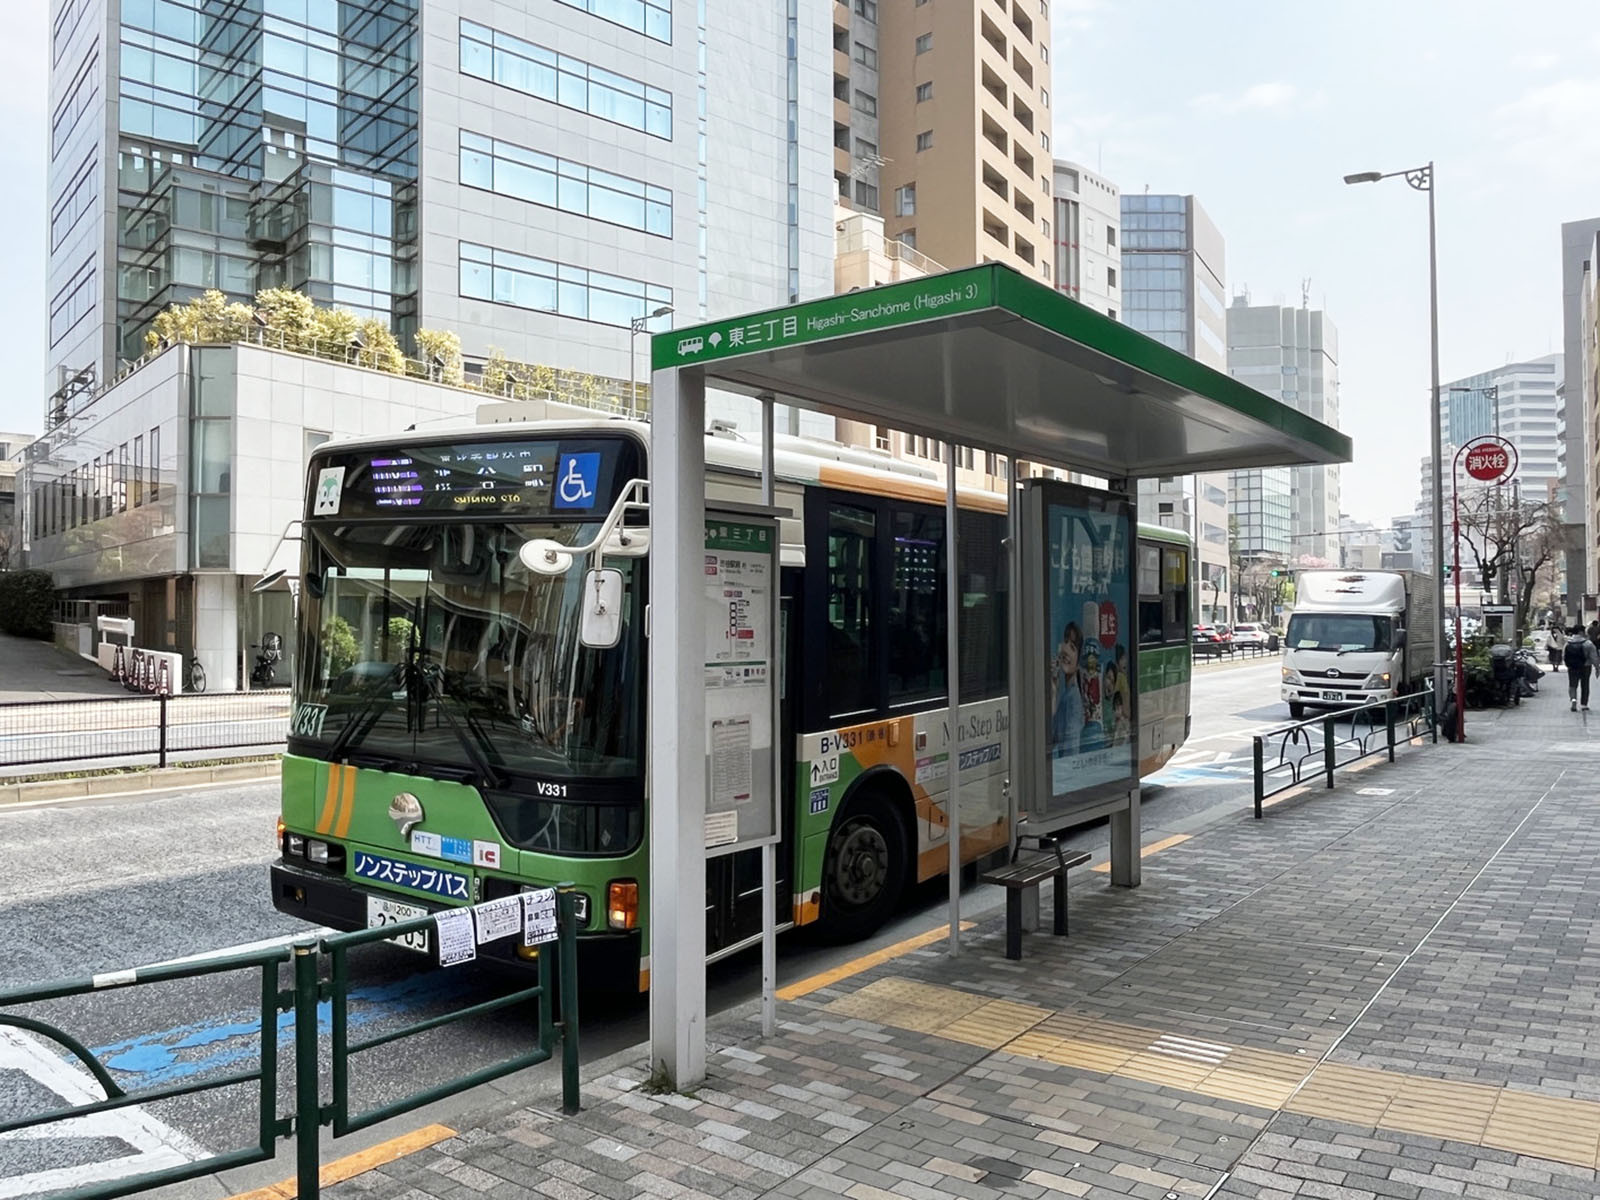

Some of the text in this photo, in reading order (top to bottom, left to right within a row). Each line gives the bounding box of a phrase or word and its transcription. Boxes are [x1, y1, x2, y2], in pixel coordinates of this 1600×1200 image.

[914, 288, 962, 311] (Higashi
[965, 283, 978, 300] 3)
[728, 315, 798, 348] 東三丁目
[1469, 453, 1505, 471] 消火栓
[942, 709, 1009, 746] Nn-Step Bu
[821, 730, 863, 754] B-V331
[822, 758, 837, 773] 入口
[959, 745, 1001, 770] ンステップバス
[537, 782, 568, 798] V331
[414, 834, 433, 846] HTT
[355, 854, 469, 899] ノンステップバス
